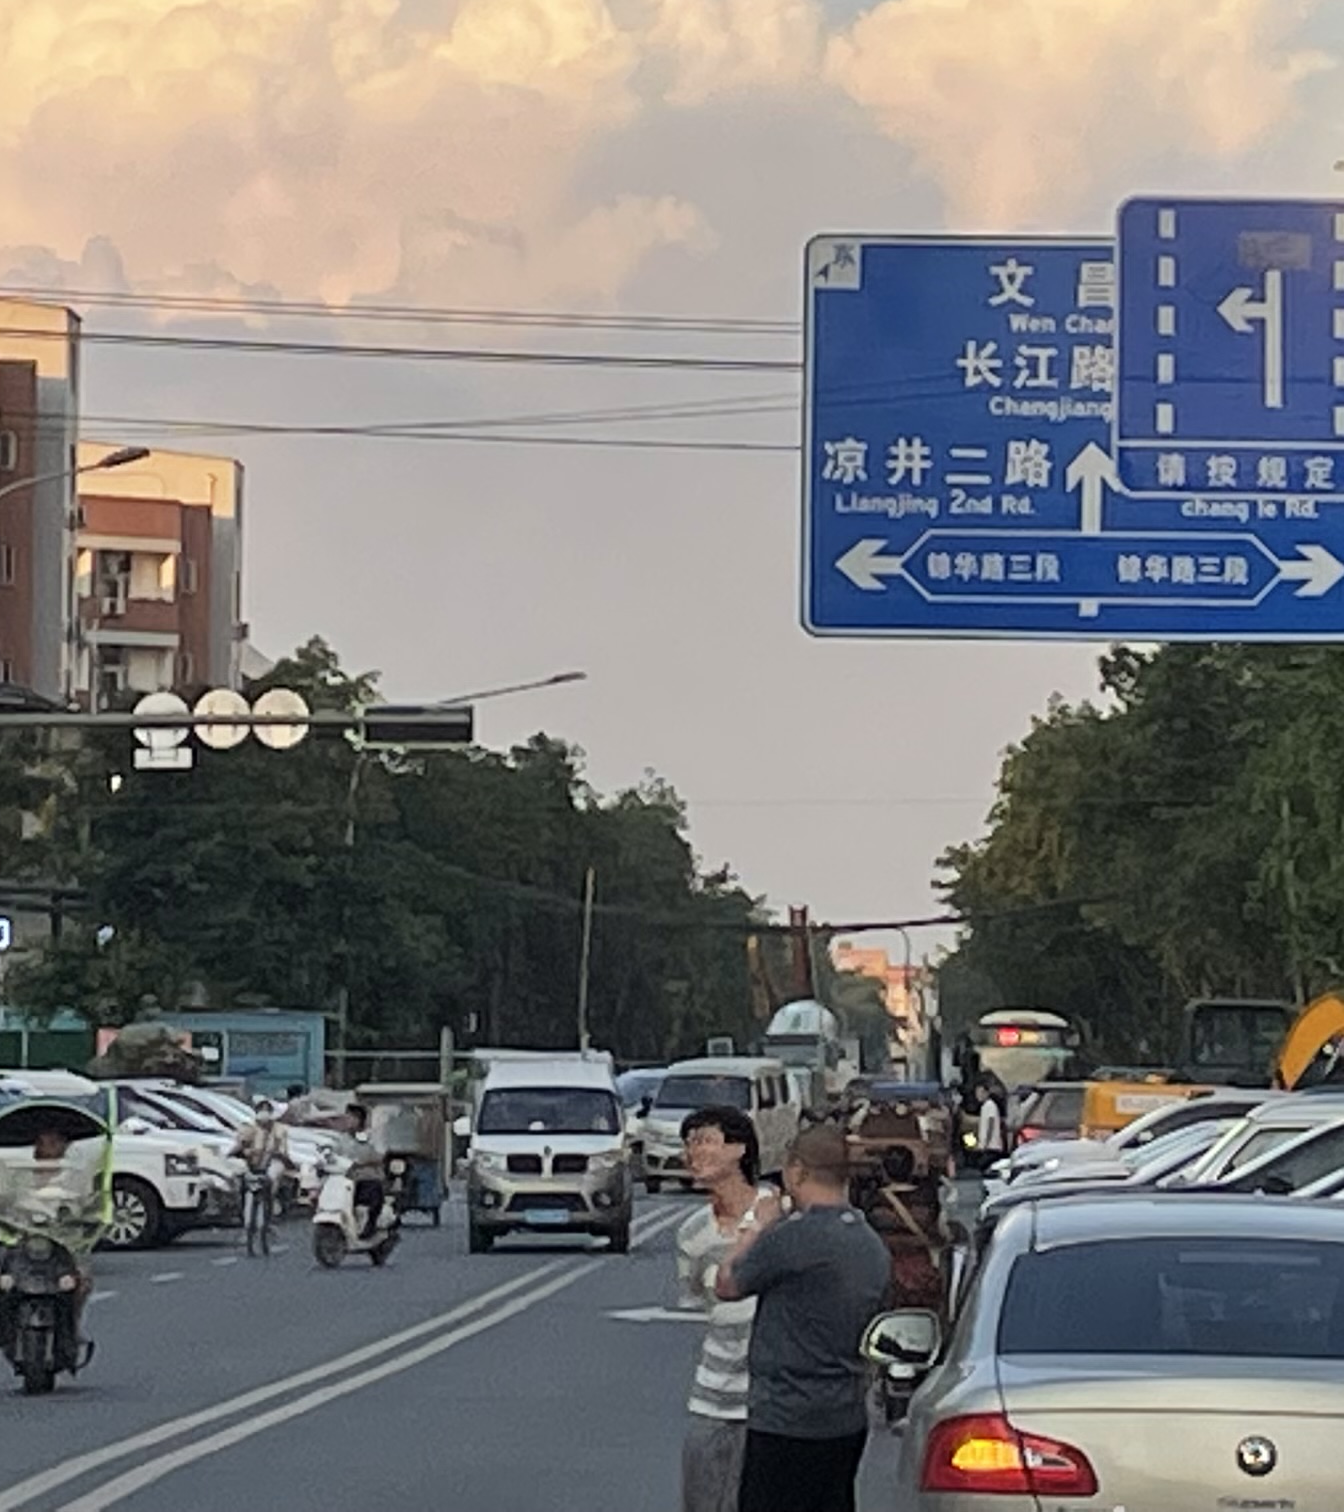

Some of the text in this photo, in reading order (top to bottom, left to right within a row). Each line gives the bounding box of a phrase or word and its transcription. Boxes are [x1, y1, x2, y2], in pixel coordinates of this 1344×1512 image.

[1009, 313, 1056, 334] Wen
[956, 340, 1114, 392] 长江路
[988, 395, 1114, 423] Changjiang
[822, 437, 1053, 487] 凉井二路
[834, 489, 1036, 519] Liangjing 2nd Rd.
[1285, 498, 1320, 520] Rd.
